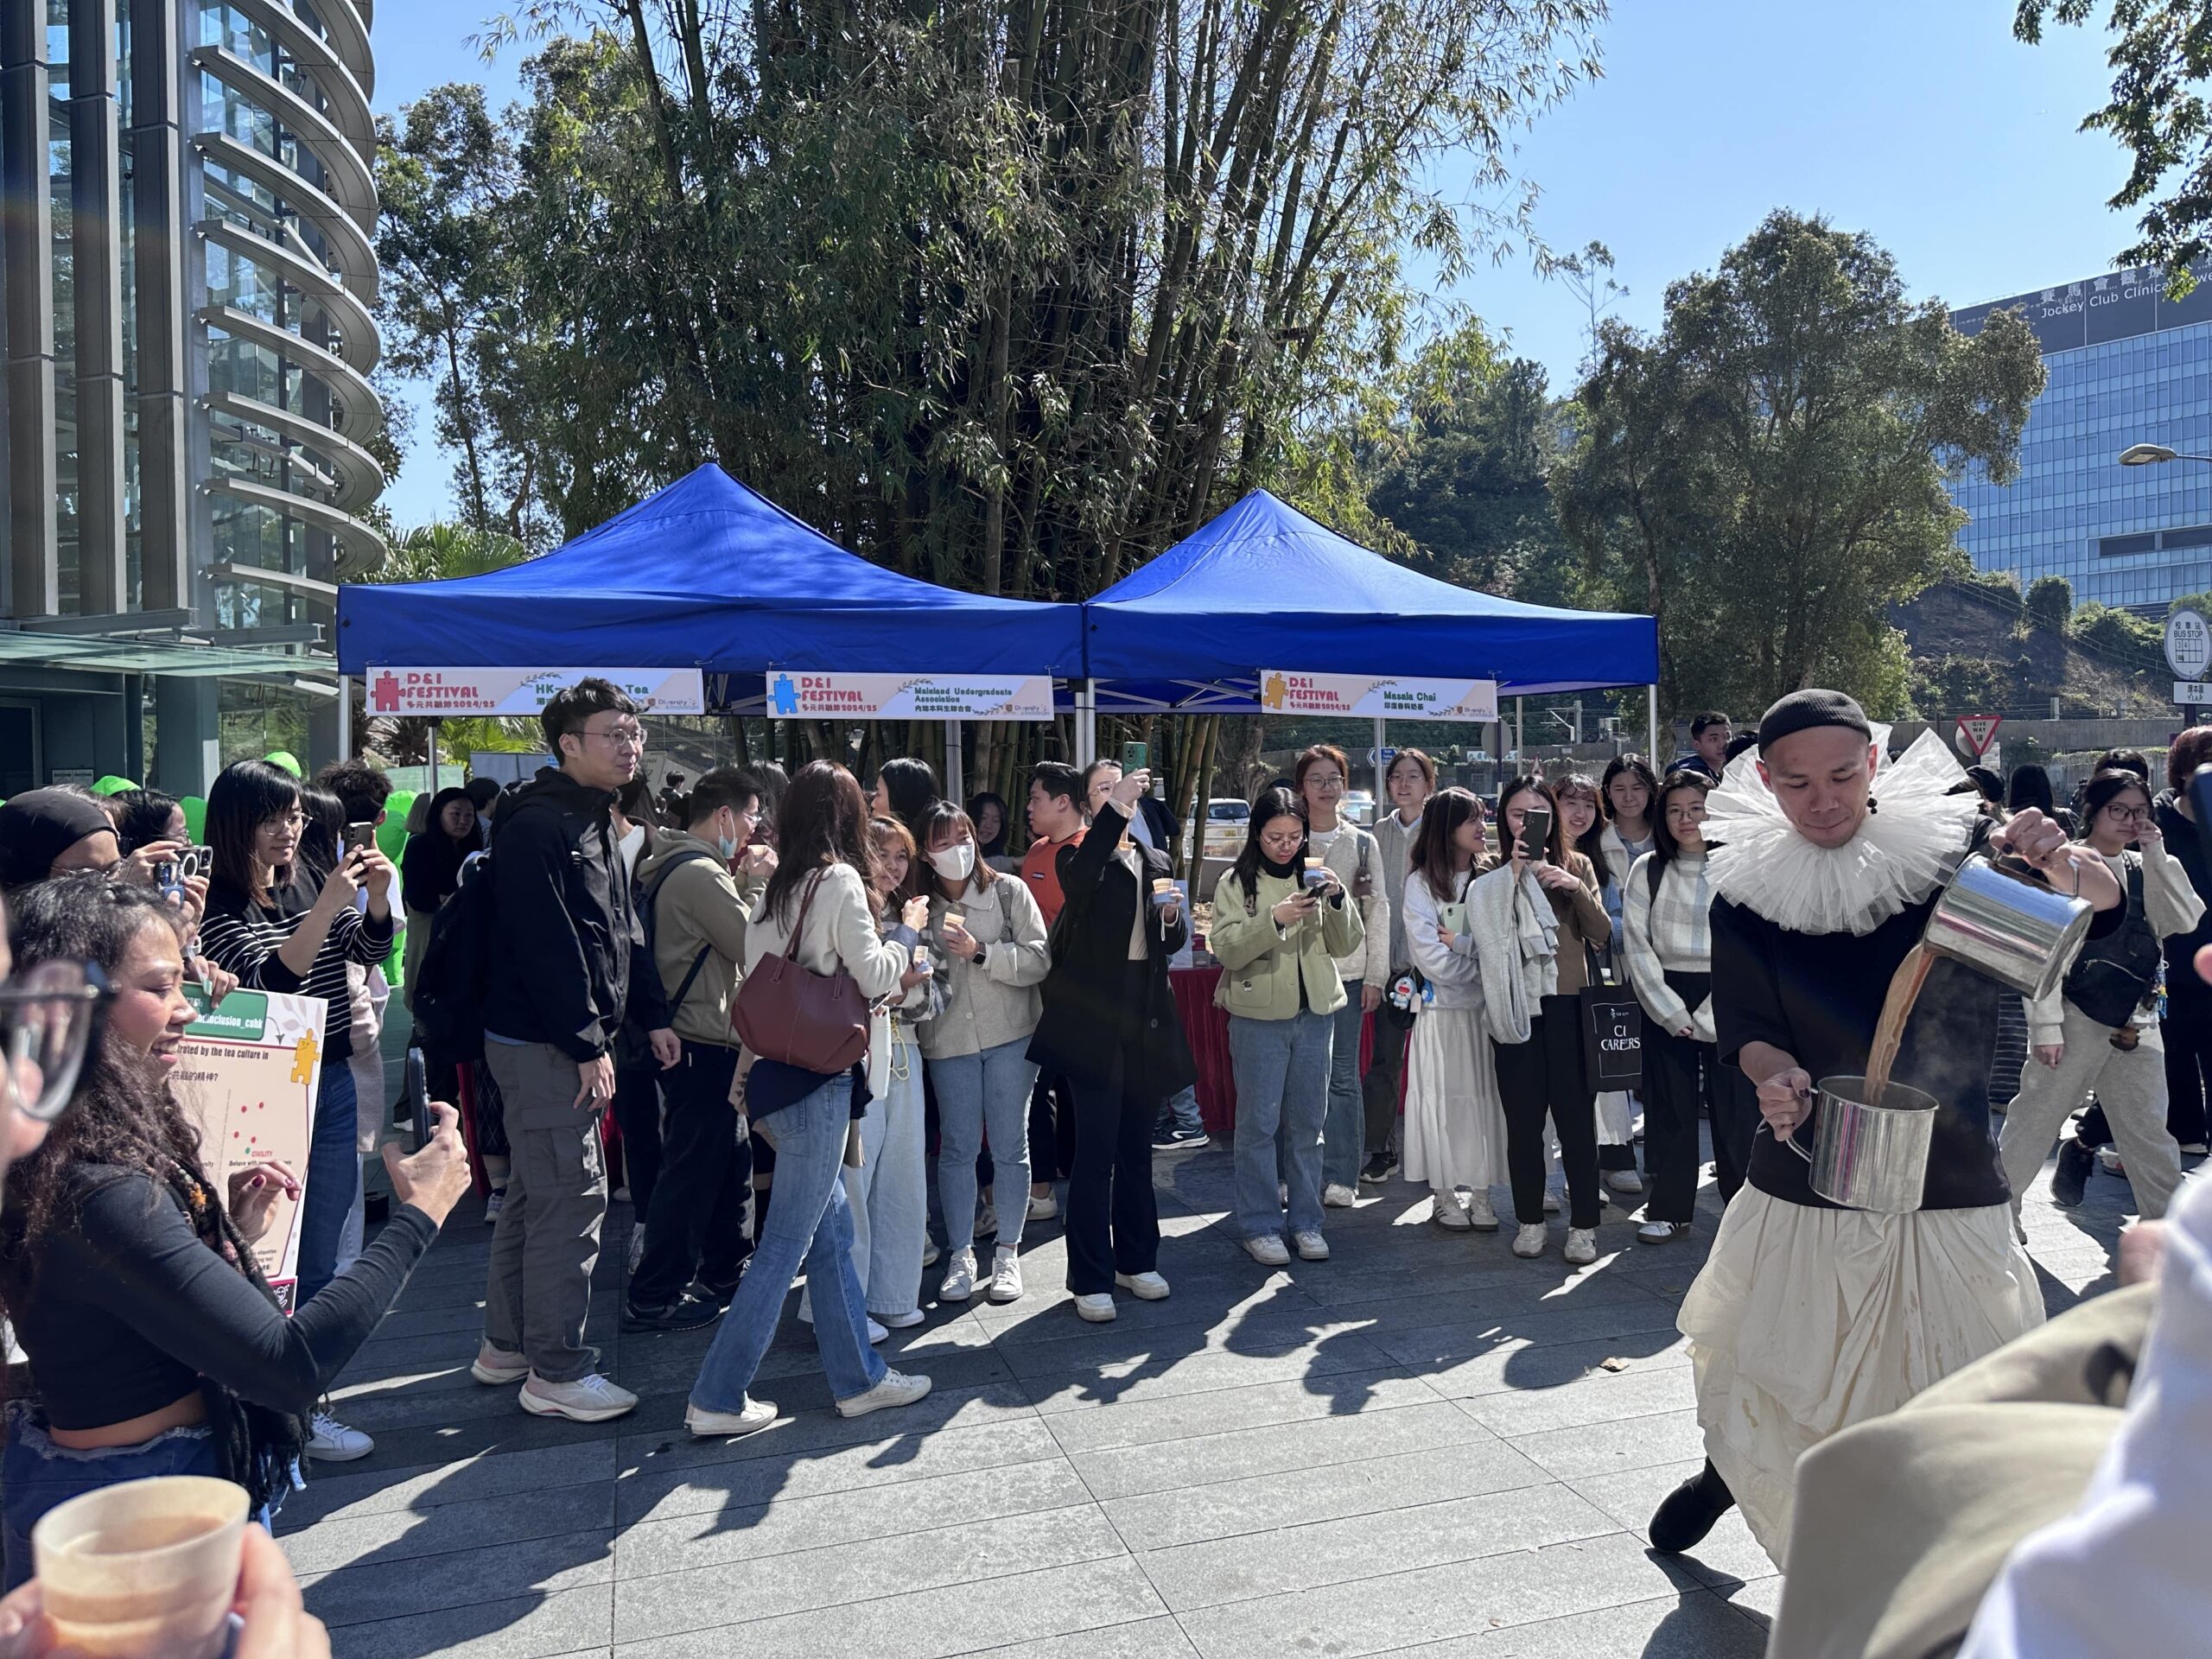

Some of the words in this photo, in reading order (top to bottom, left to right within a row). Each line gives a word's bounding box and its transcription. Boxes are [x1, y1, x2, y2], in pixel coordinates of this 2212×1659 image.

[2041, 301, 2085, 319] Jockey
[2089, 292, 2119, 308] Club
[407, 673, 442, 684] D&I
[802, 677, 831, 689] D&I
[1289, 677, 1313, 688] D&I
[407, 686, 479, 698] FESTIVAL
[626, 684, 649, 694] Tea
[955, 688, 1012, 696] Undergraduate
[802, 690, 862, 702] FESTIVAL
[1289, 690, 1338, 701] FESTIVAL
[1384, 691, 1414, 701] Masala
[1417, 692, 1436, 702] Chai
[177, 1045, 199, 1054] trated
[200, 1045, 209, 1056] by
[211, 1047, 222, 1056] the
[225, 1048, 236, 1057] tea
[237, 1049, 261, 1059] culture
[262, 1051, 270, 1059] in
